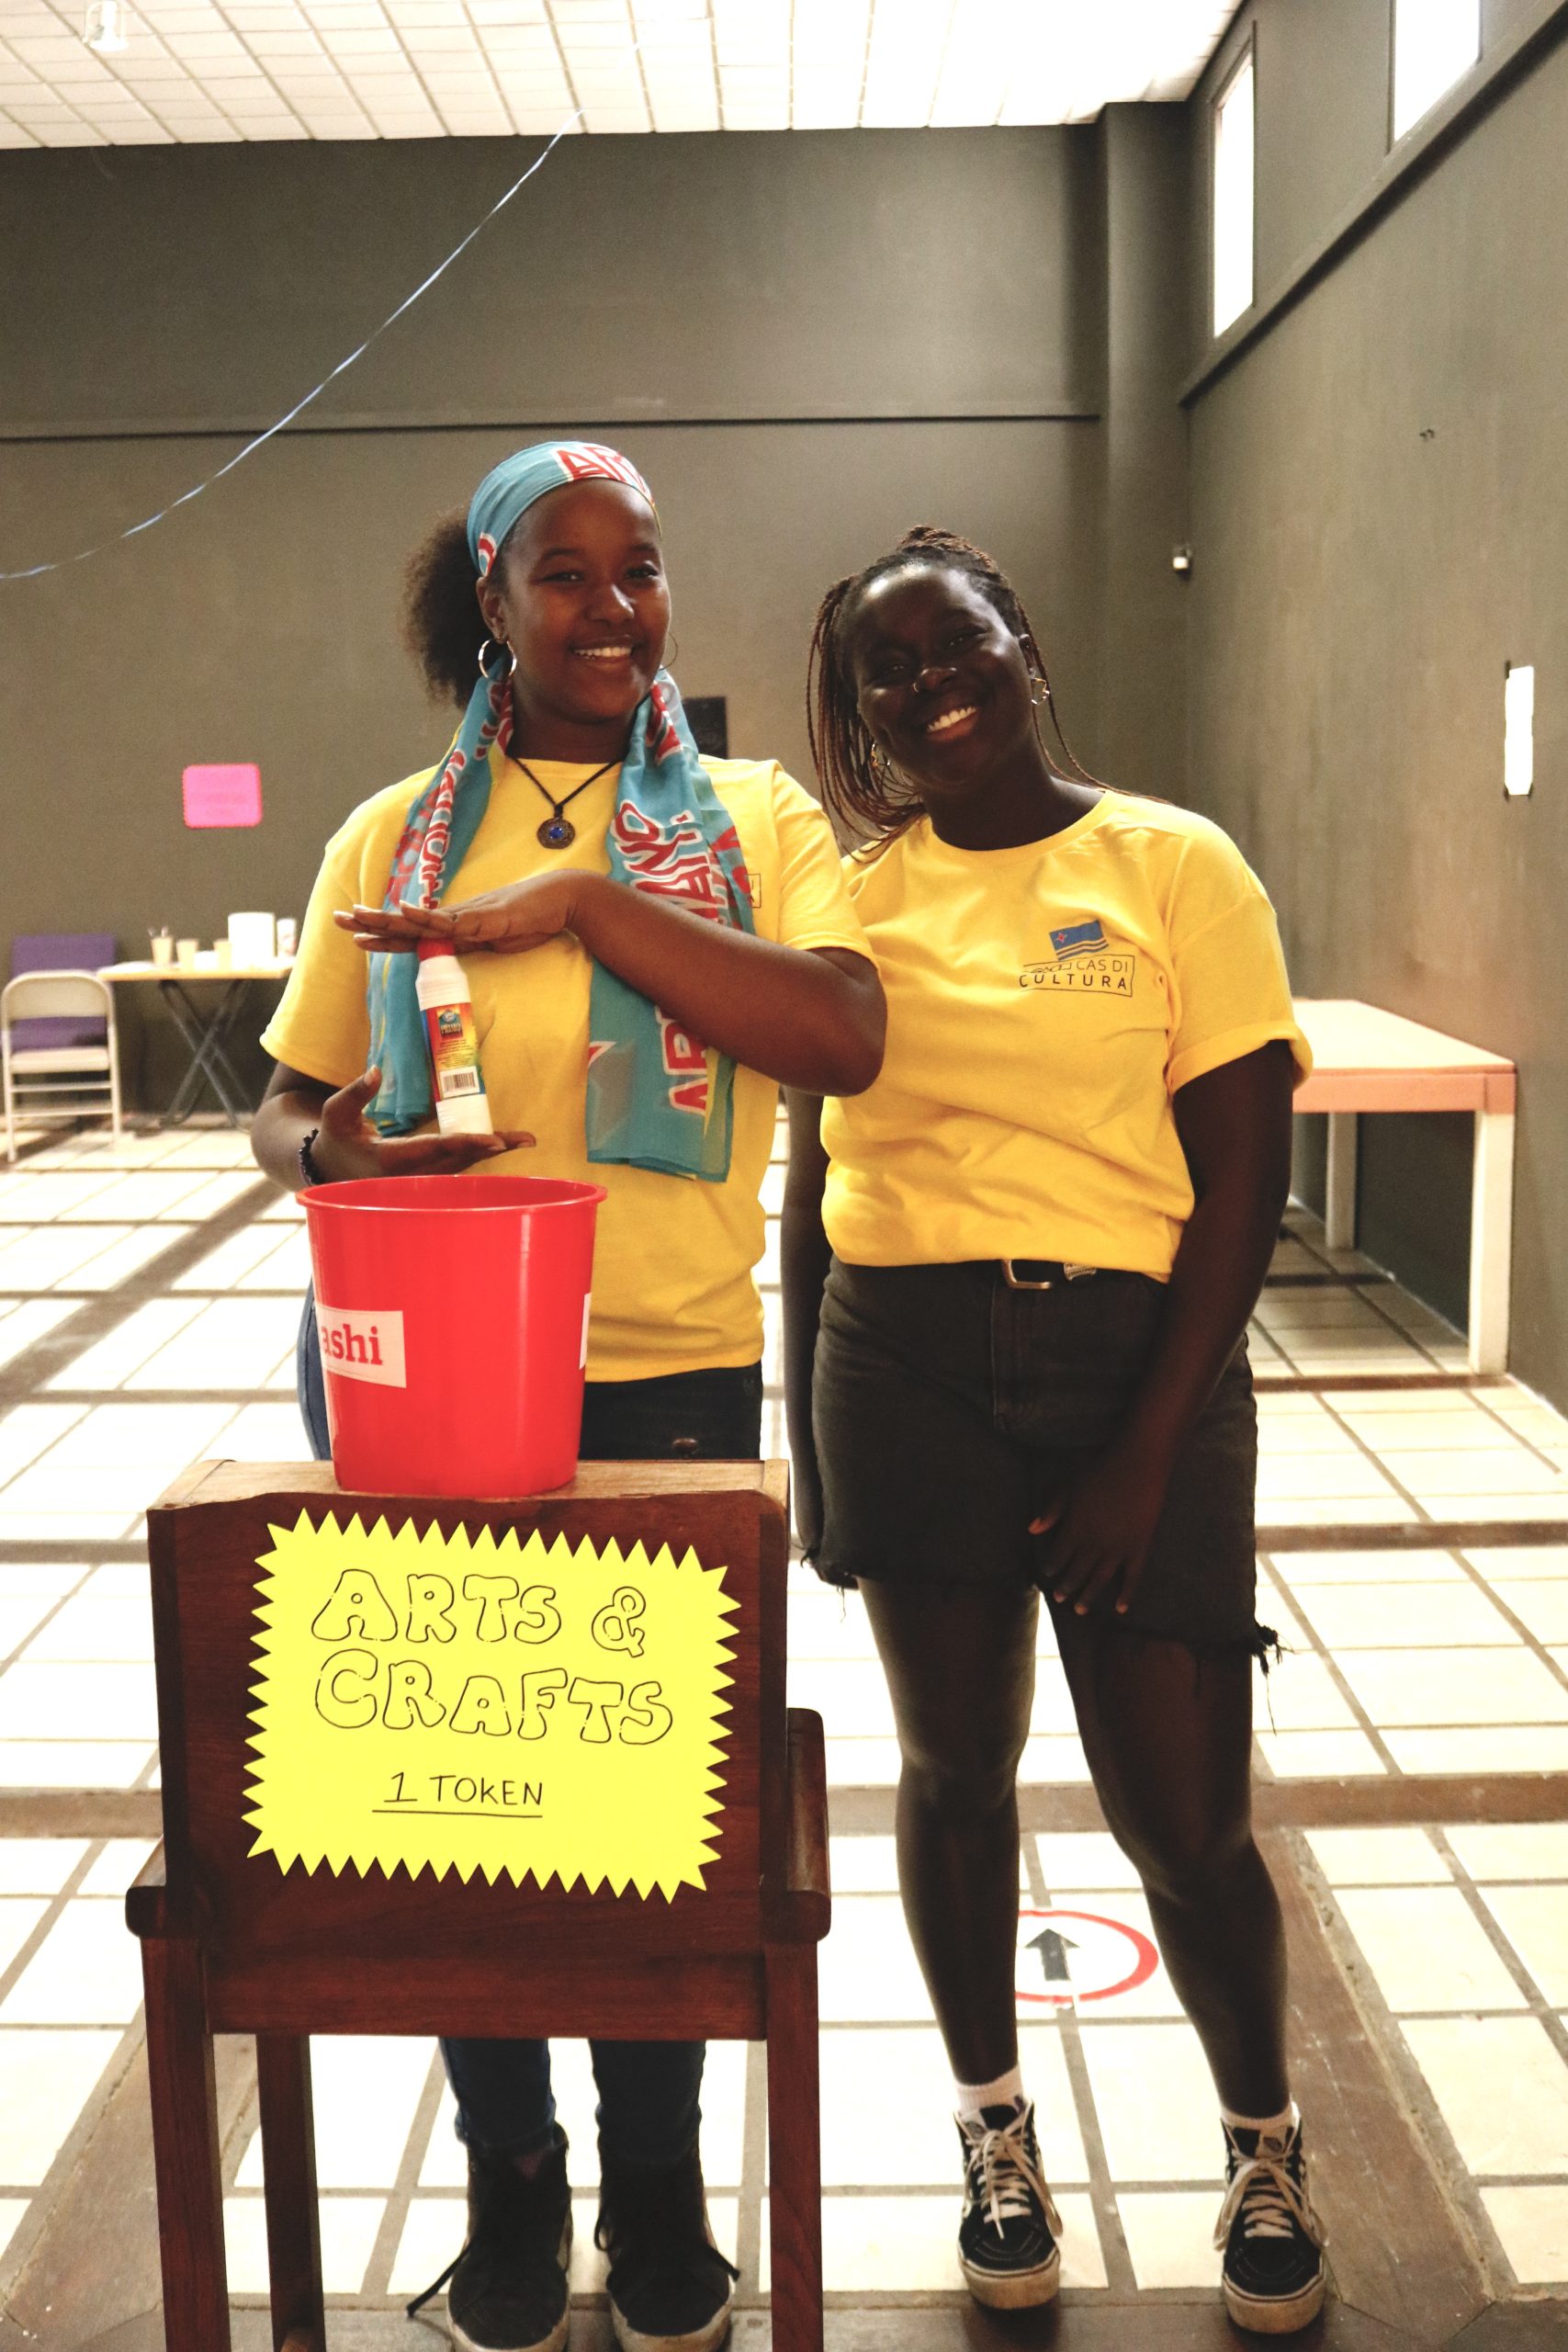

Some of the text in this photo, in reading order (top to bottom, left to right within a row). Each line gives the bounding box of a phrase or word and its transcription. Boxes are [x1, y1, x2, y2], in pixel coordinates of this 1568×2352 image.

[1019, 973, 1127, 990] CULTURA
[1112, 960, 1128, 973] DI
[310, 1568, 647, 1658] ARTS &
[314, 1648, 674, 1746] CRAFTS
[383, 1771, 544, 1806] 1 TOKEN
